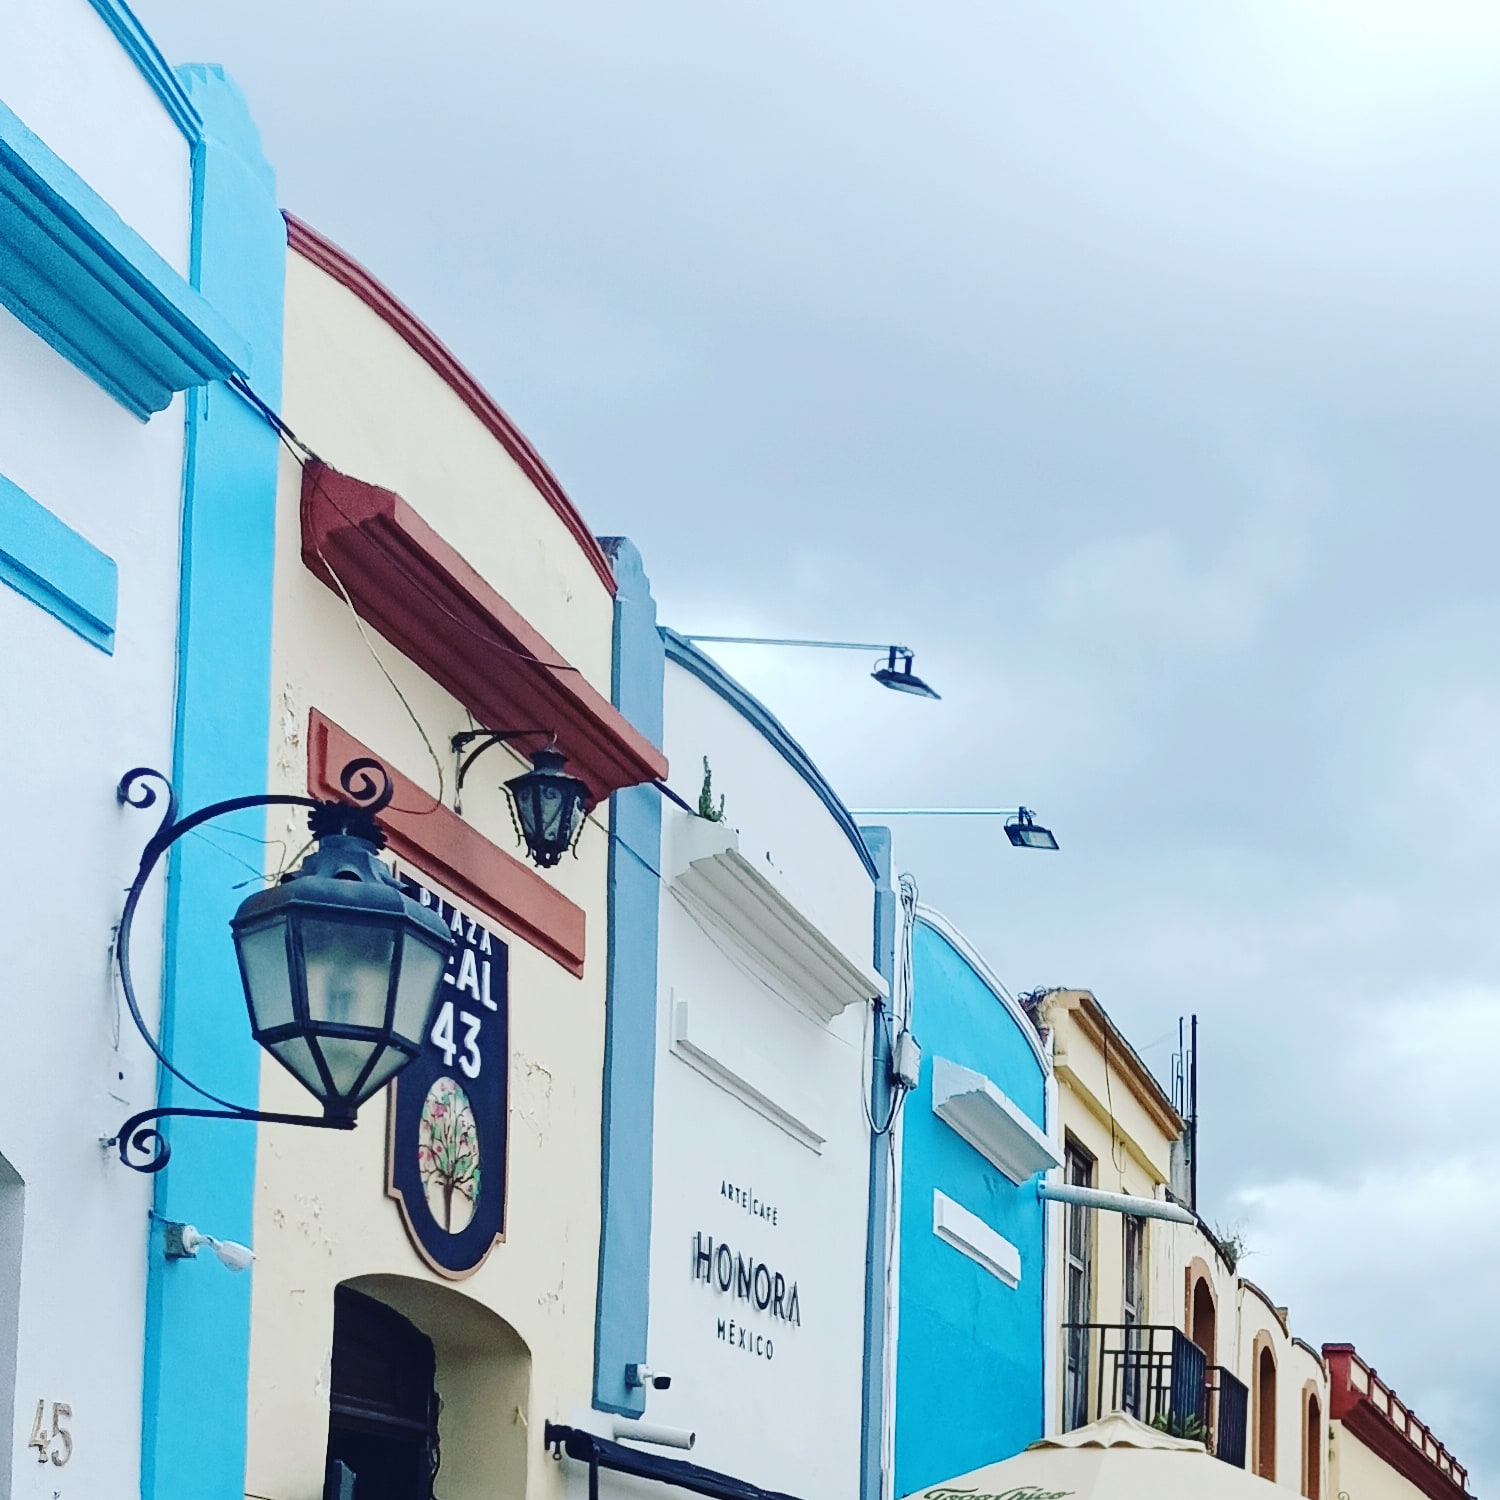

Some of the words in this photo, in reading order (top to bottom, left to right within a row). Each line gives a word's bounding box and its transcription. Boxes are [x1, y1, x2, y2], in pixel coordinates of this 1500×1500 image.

[431, 1001, 482, 1079] 43
[695, 1231, 801, 1327] HONORA
[717, 1317, 774, 1361] MÉXICO
[28, 1399, 73, 1467] 45
